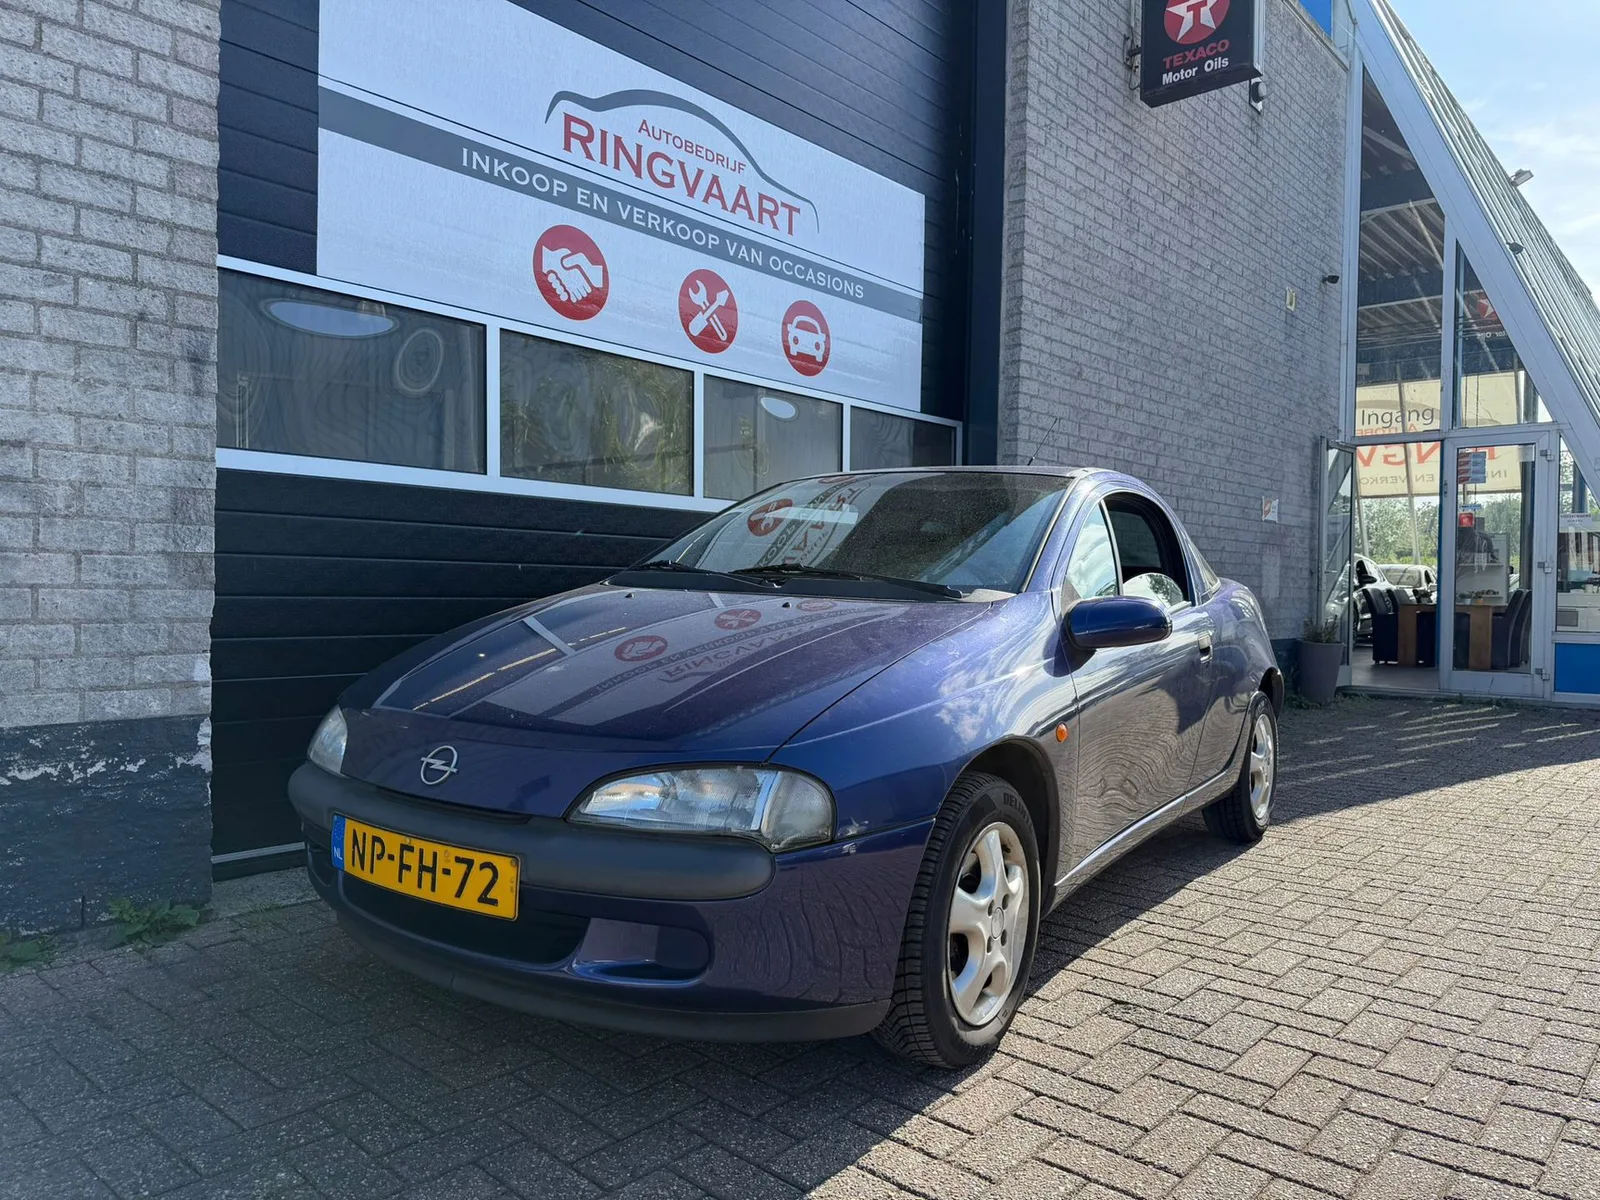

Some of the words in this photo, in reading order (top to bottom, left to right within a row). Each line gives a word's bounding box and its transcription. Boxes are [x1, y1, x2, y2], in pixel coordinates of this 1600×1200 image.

[1162, 66, 1198, 85] Motor
[1204, 57, 1229, 73] Oils
[1163, 39, 1230, 69] TEXACO
[562, 112, 800, 236] RINGVAART
[638, 119, 747, 174] AUTOBEDRIJF
[462, 147, 568, 197] INKOOP
[576, 187, 609, 214] EN
[617, 201, 720, 249] VERKOOP
[726, 239, 763, 266] VAN
[769, 256, 864, 299] OCCASIONS
[1361, 407, 1434, 429] Ingang
[352, 828, 499, 907] NP-FH-72
